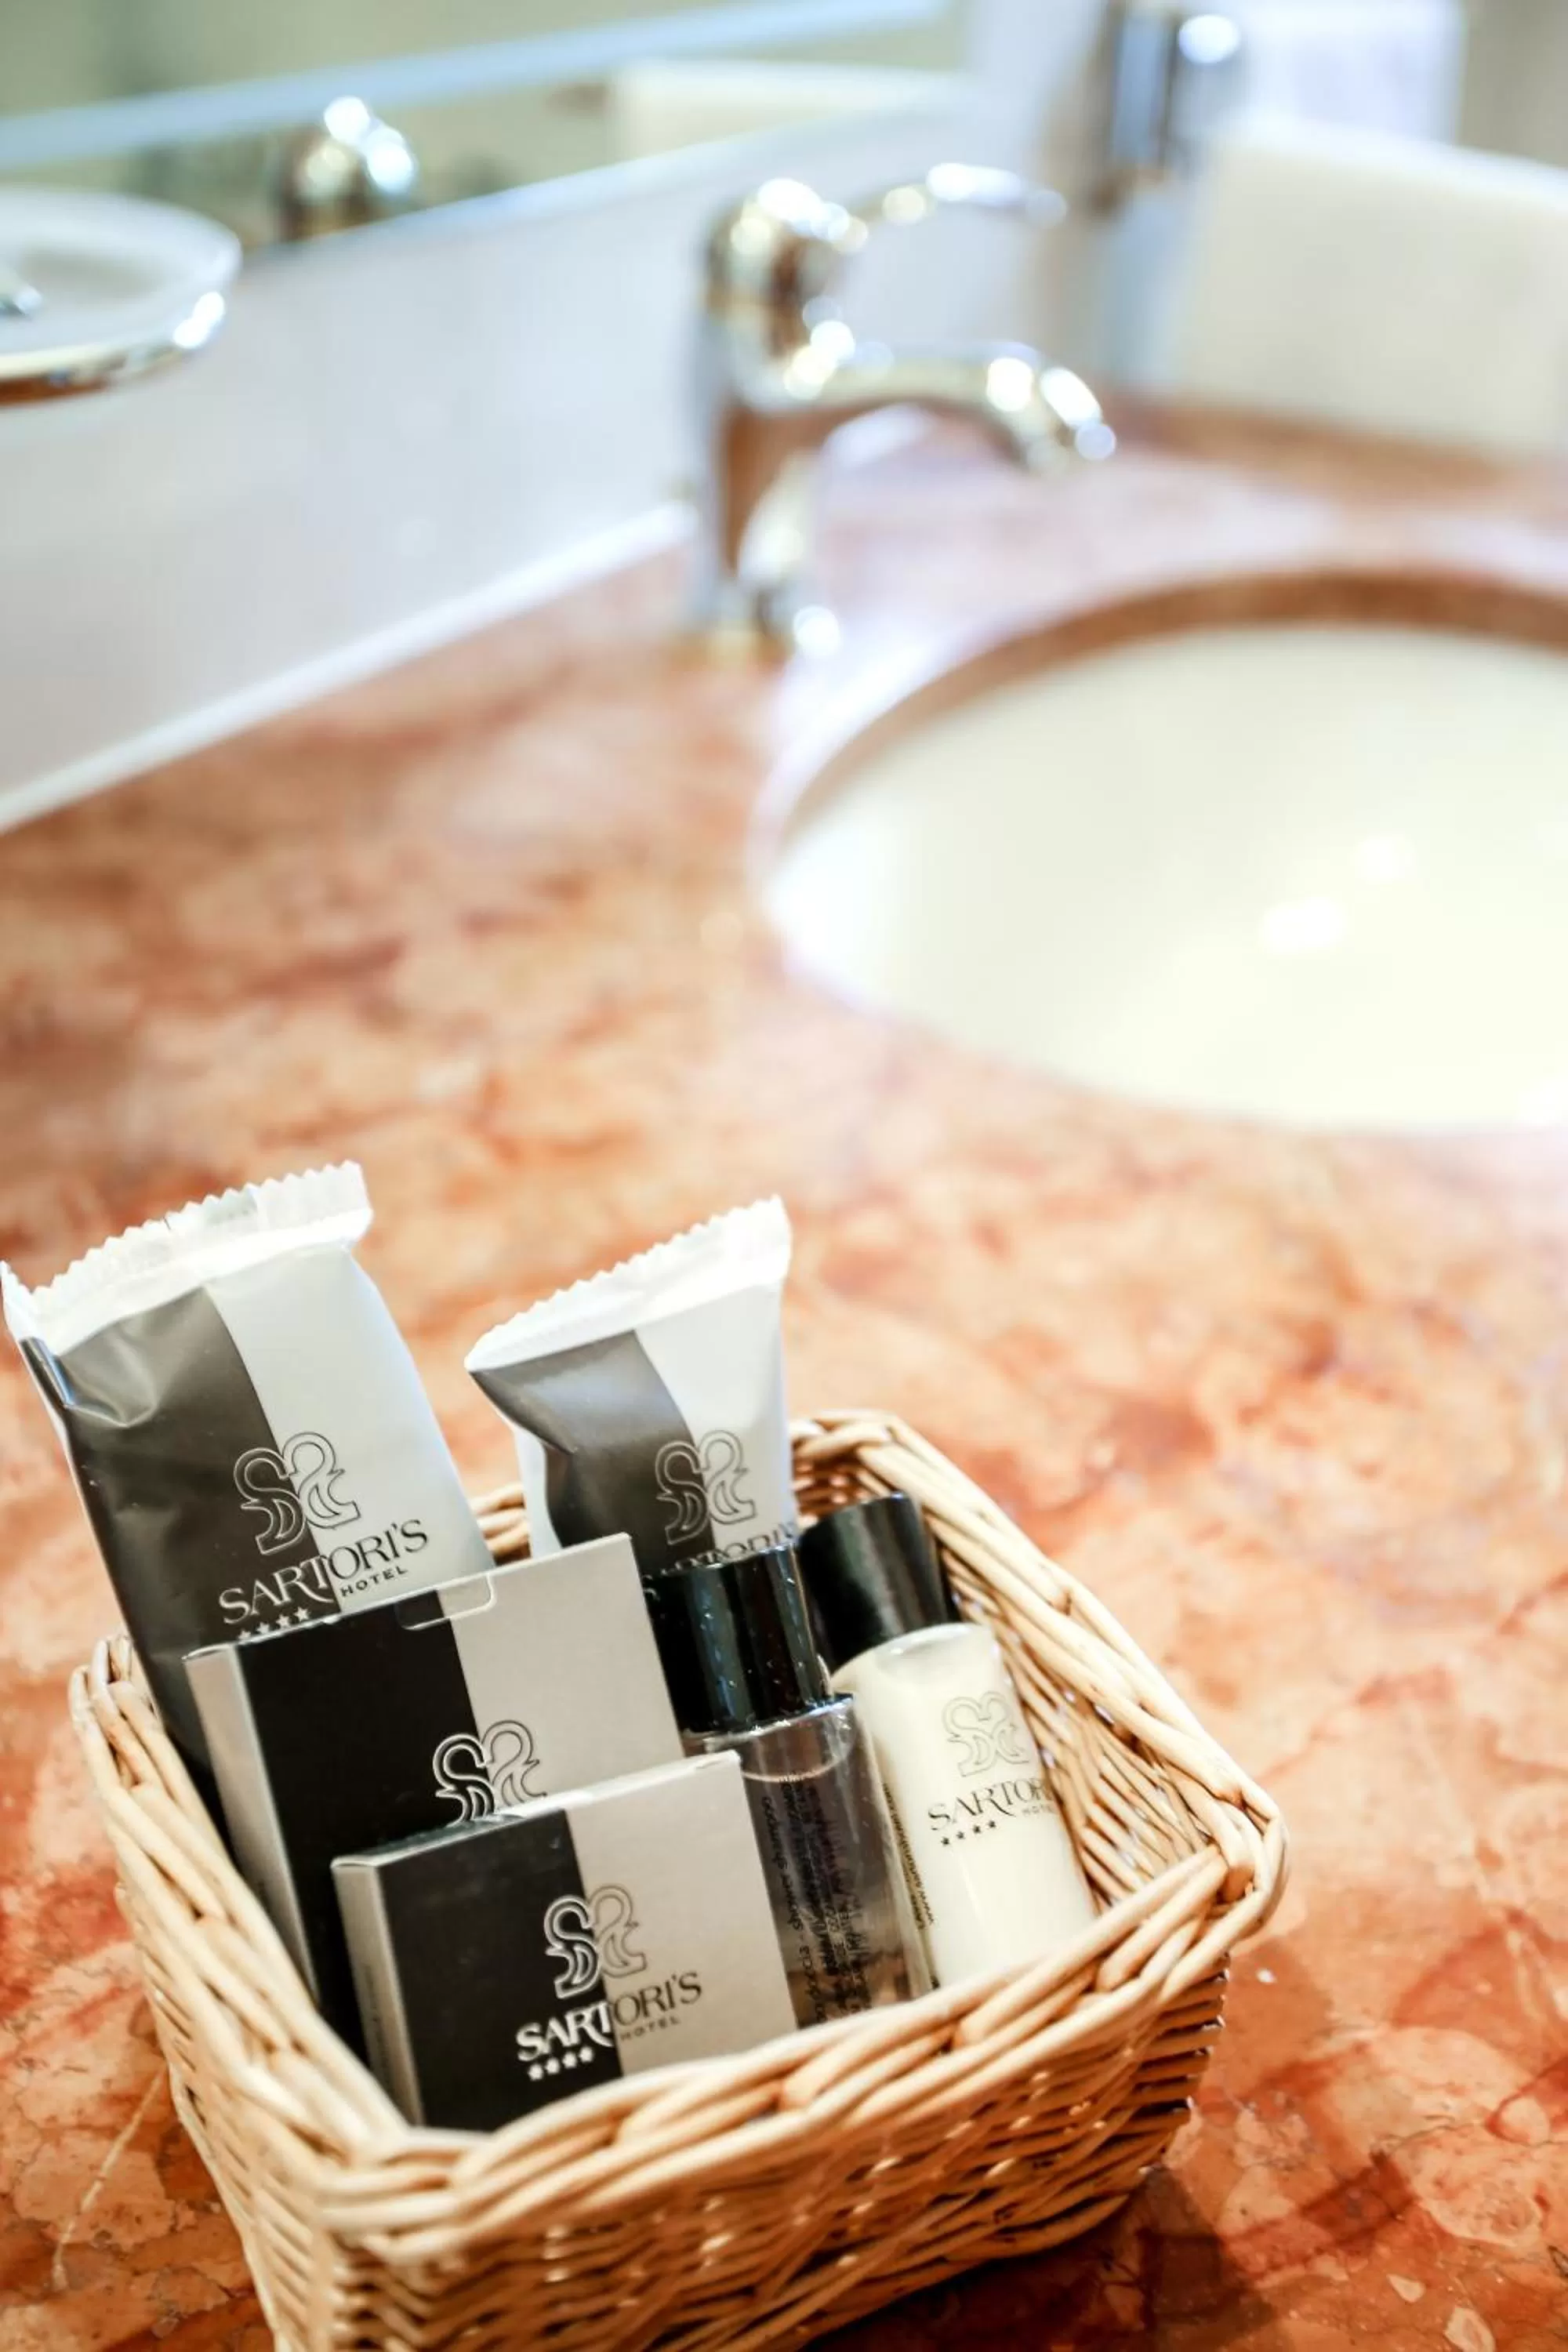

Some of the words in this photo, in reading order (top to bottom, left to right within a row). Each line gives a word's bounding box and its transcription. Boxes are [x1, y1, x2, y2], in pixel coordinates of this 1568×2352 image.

[219, 1519, 428, 1624] SARTORI'S
[340, 1566, 408, 1597] HOTEL
[515, 1971, 702, 2062] SARTORI'S
[620, 2016, 681, 2042] HOTEL
